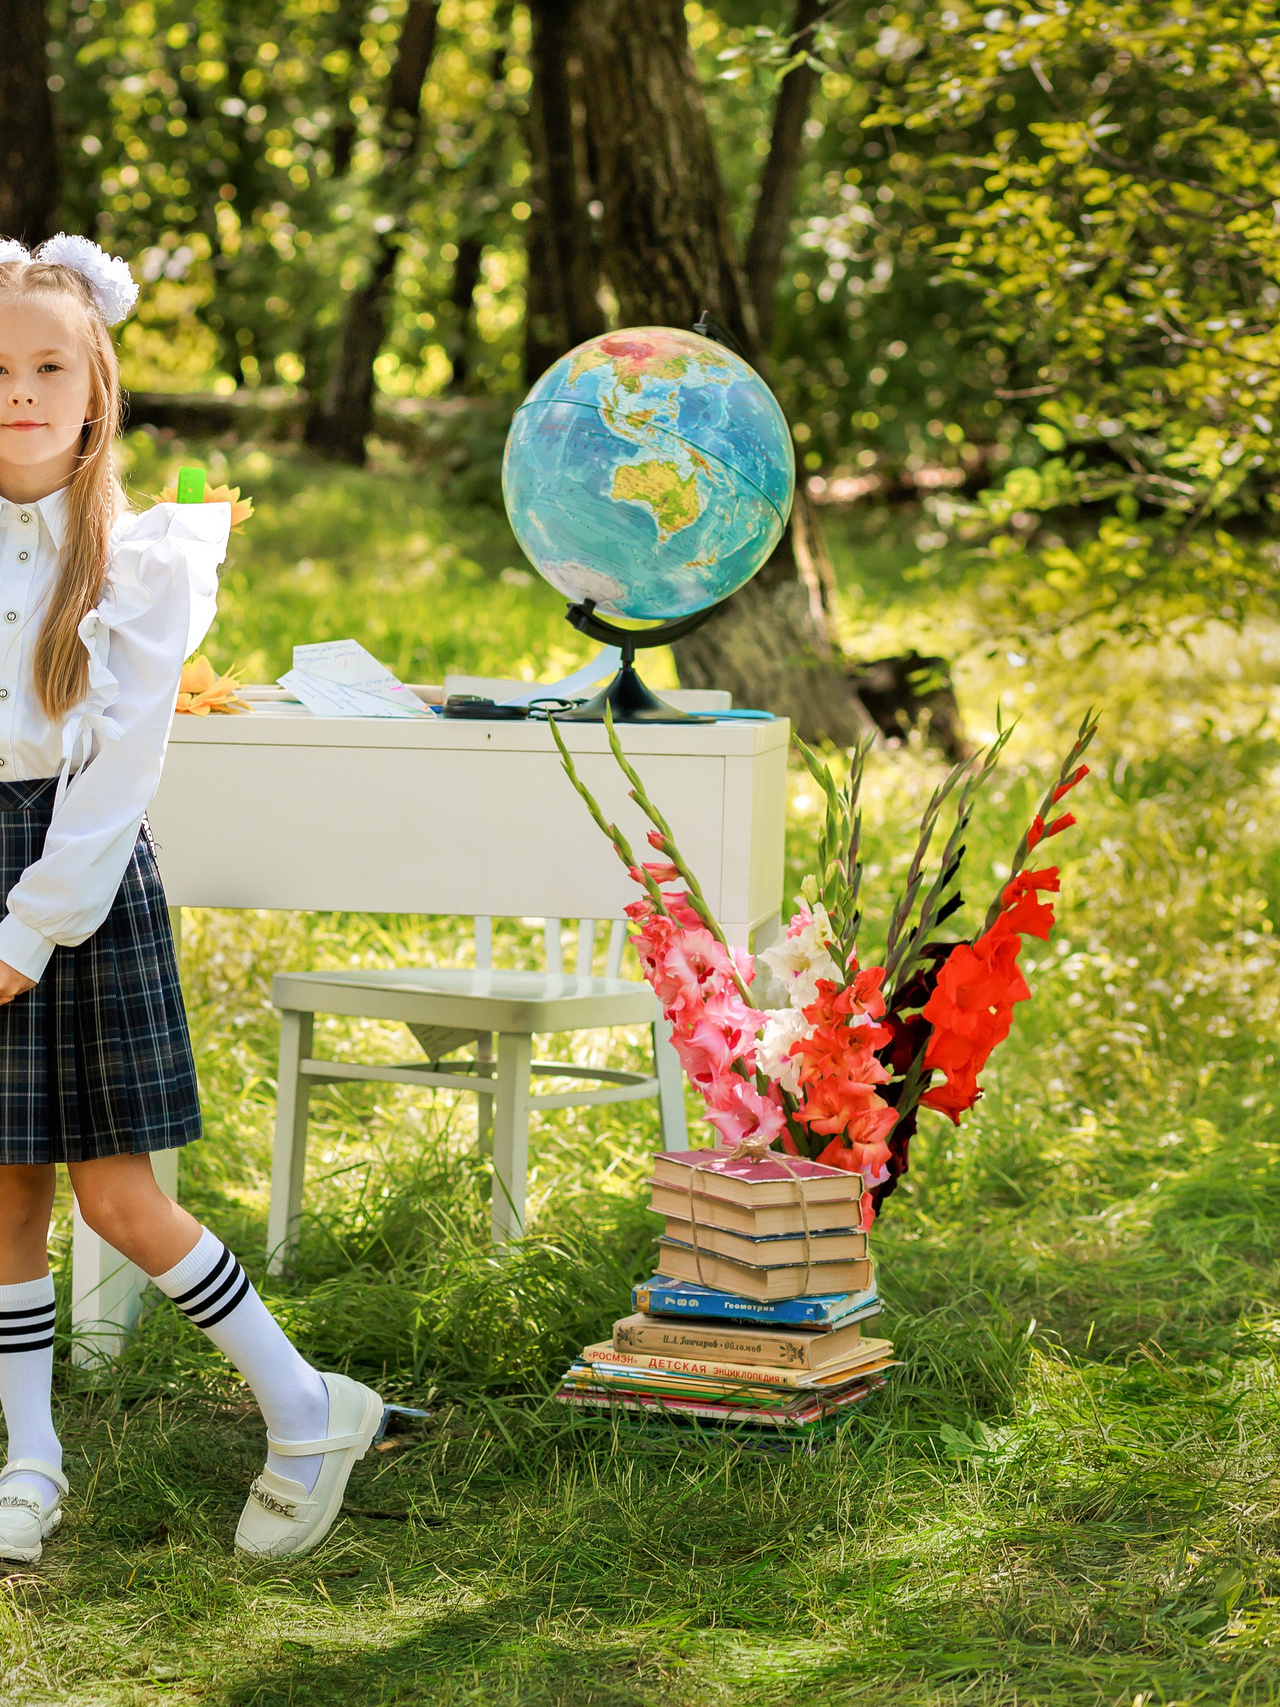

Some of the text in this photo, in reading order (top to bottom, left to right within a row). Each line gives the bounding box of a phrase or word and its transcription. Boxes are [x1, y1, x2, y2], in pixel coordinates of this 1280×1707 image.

[665, 1296, 676, 1305] 7
[677, 1298, 688, 1307] 8
[724, 1302, 775, 1312] Геометрия
[680, 1337, 718, 1348] Гончаров
[724, 1341, 762, 1353] Обломов
[648, 1358, 707, 1374] ДЕТСКАЯ
[713, 1367, 780, 1384] ЭНЦИКЛОПЕДИЯ
